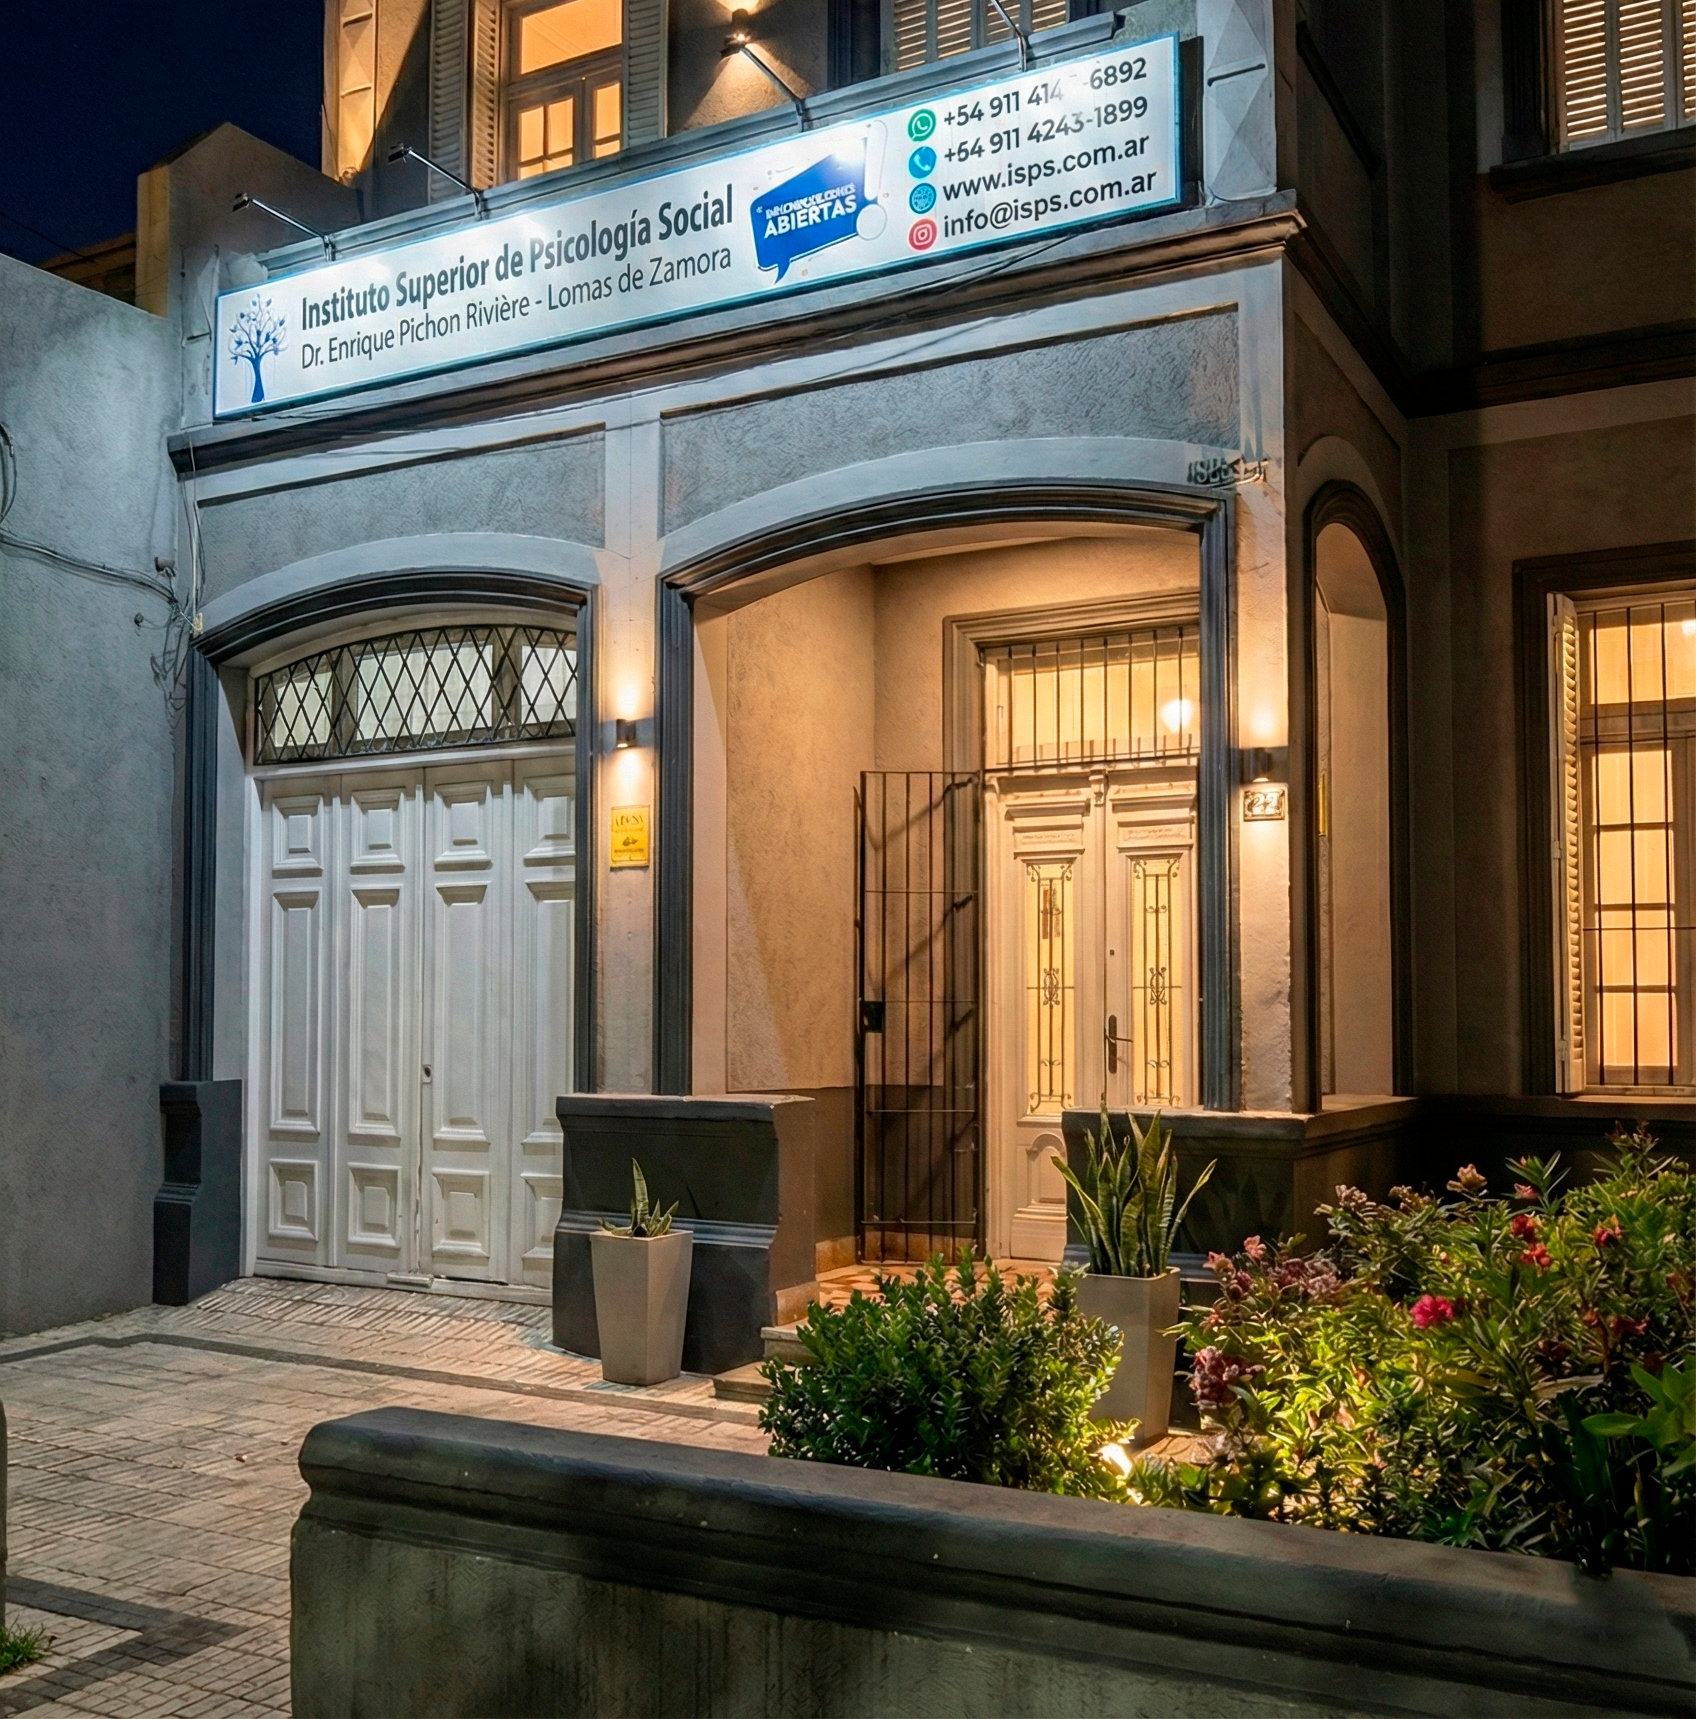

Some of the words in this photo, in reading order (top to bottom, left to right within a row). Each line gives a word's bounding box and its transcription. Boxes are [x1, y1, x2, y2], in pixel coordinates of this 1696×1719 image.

[943, 100, 985, 127] +54
[989, 91, 1020, 118] 911
[989, 127, 1020, 154] 911
[1026, 96, 1149, 143] 4243-1899
[942, 135, 1150, 201] www.isps.com.ar
[763, 194, 858, 240] ABIERTAS
[943, 171, 1158, 238] info@isps.com.ar
[301, 285, 391, 331] Instituto
[395, 255, 490, 310] Superior
[495, 243, 524, 281] de
[529, 209, 652, 273] Psicología
[658, 183, 734, 241] Social
[301, 343, 324, 369] Dr.
[328, 329, 395, 360] Enrique
[399, 313, 461, 346] Pichon
[466, 295, 530, 329] Rivière
[547, 276, 613, 310] Lomas
[618, 263, 644, 293] de
[649, 247, 732, 286] Zamora
